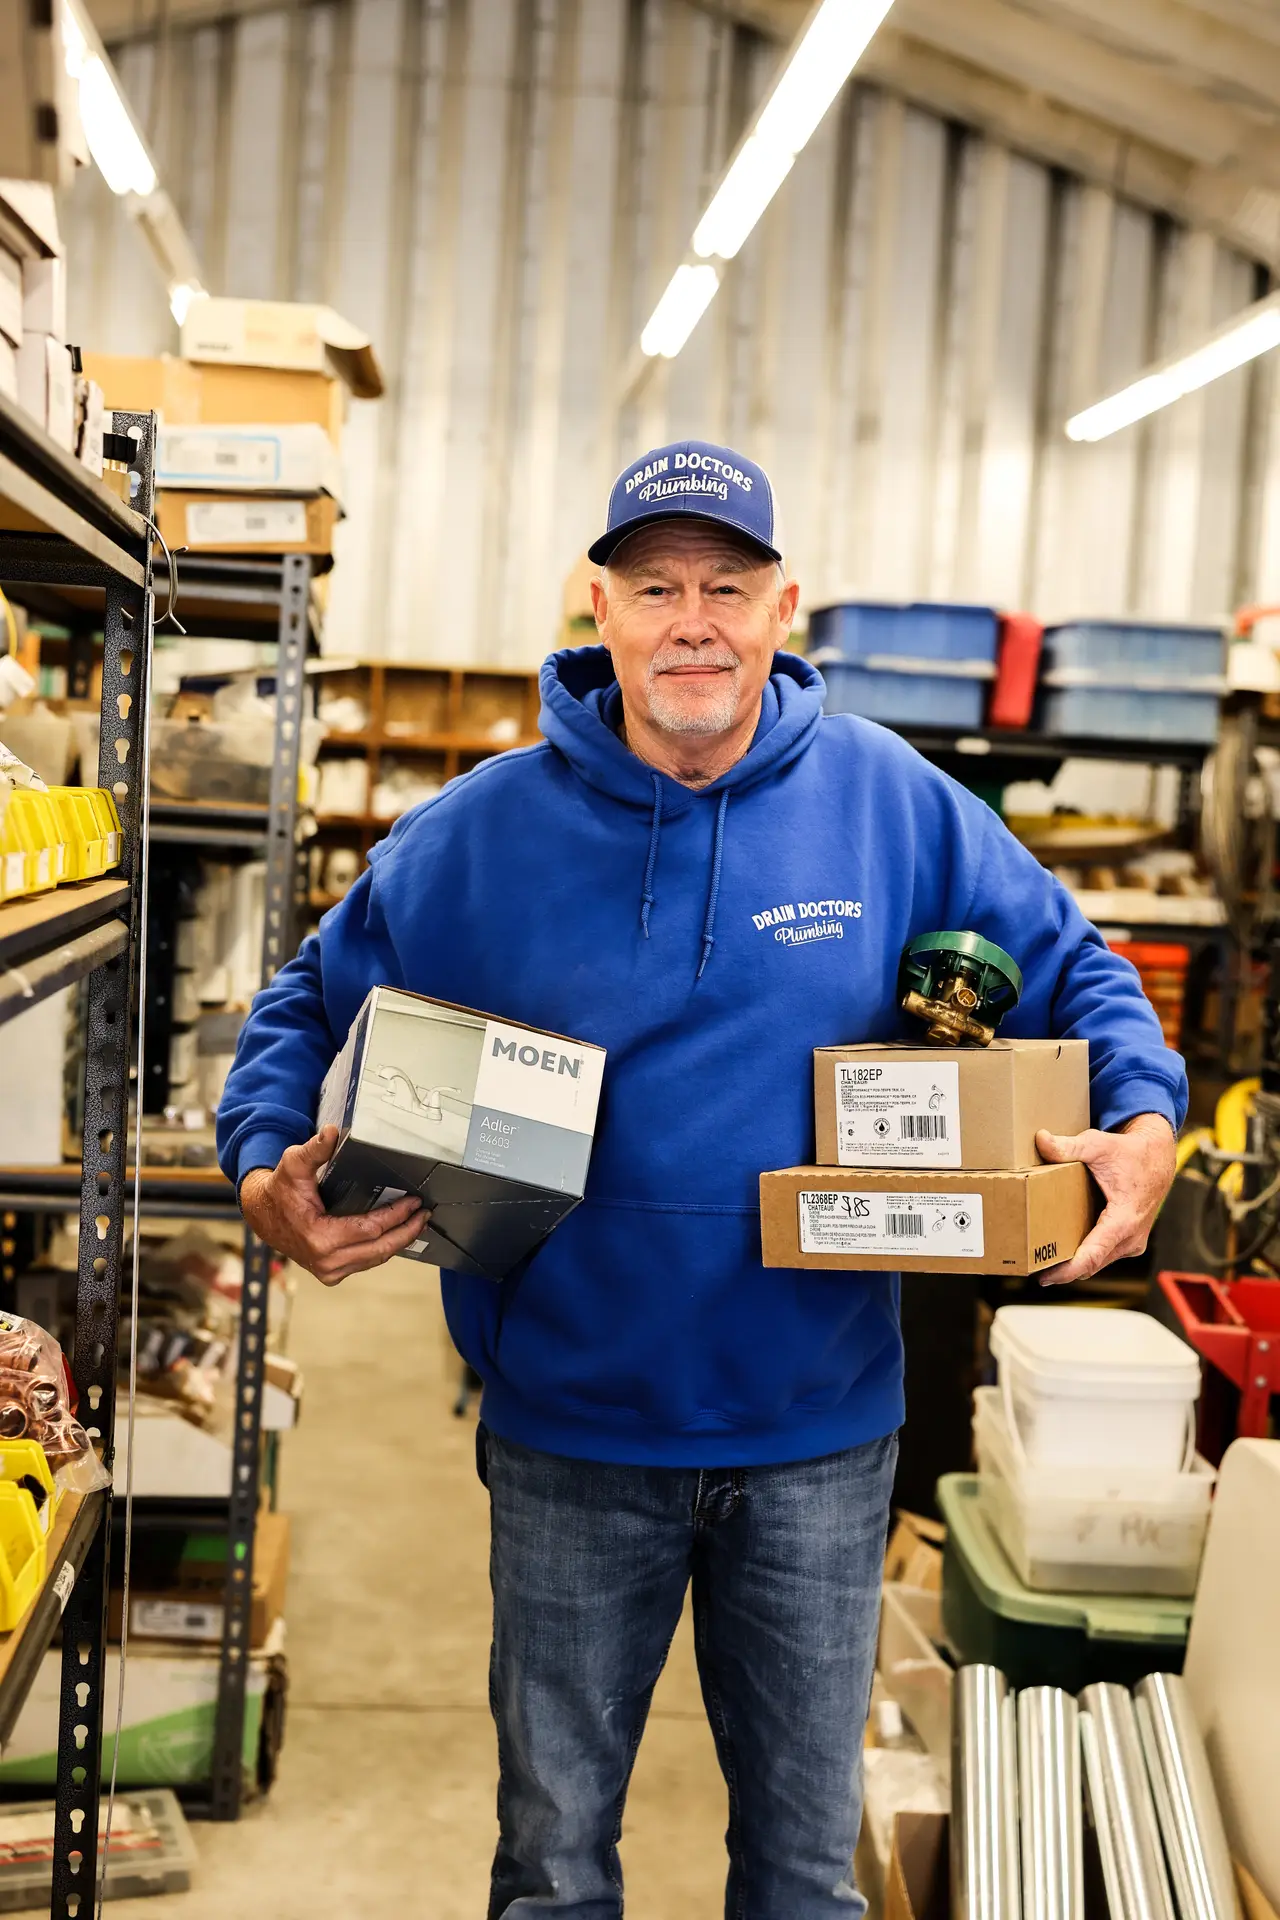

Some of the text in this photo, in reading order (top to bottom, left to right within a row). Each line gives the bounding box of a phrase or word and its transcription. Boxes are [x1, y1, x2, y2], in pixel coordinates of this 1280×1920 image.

[624, 452, 753, 495] DRAIN DOCTORS
[638, 473, 729, 502] Plumbing
[751, 899, 863, 931] DRAIN DOCTORS
[774, 919, 844, 946] Plumbing
[491, 1036, 581, 1080] MOEN
[840, 1068, 883, 1081] TL182EP
[480, 1116, 517, 1136] Adler
[479, 1132, 510, 1149] 84603
[801, 1193, 839, 1205] TL2368EP
[1034, 1241, 1058, 1265] MOEN
